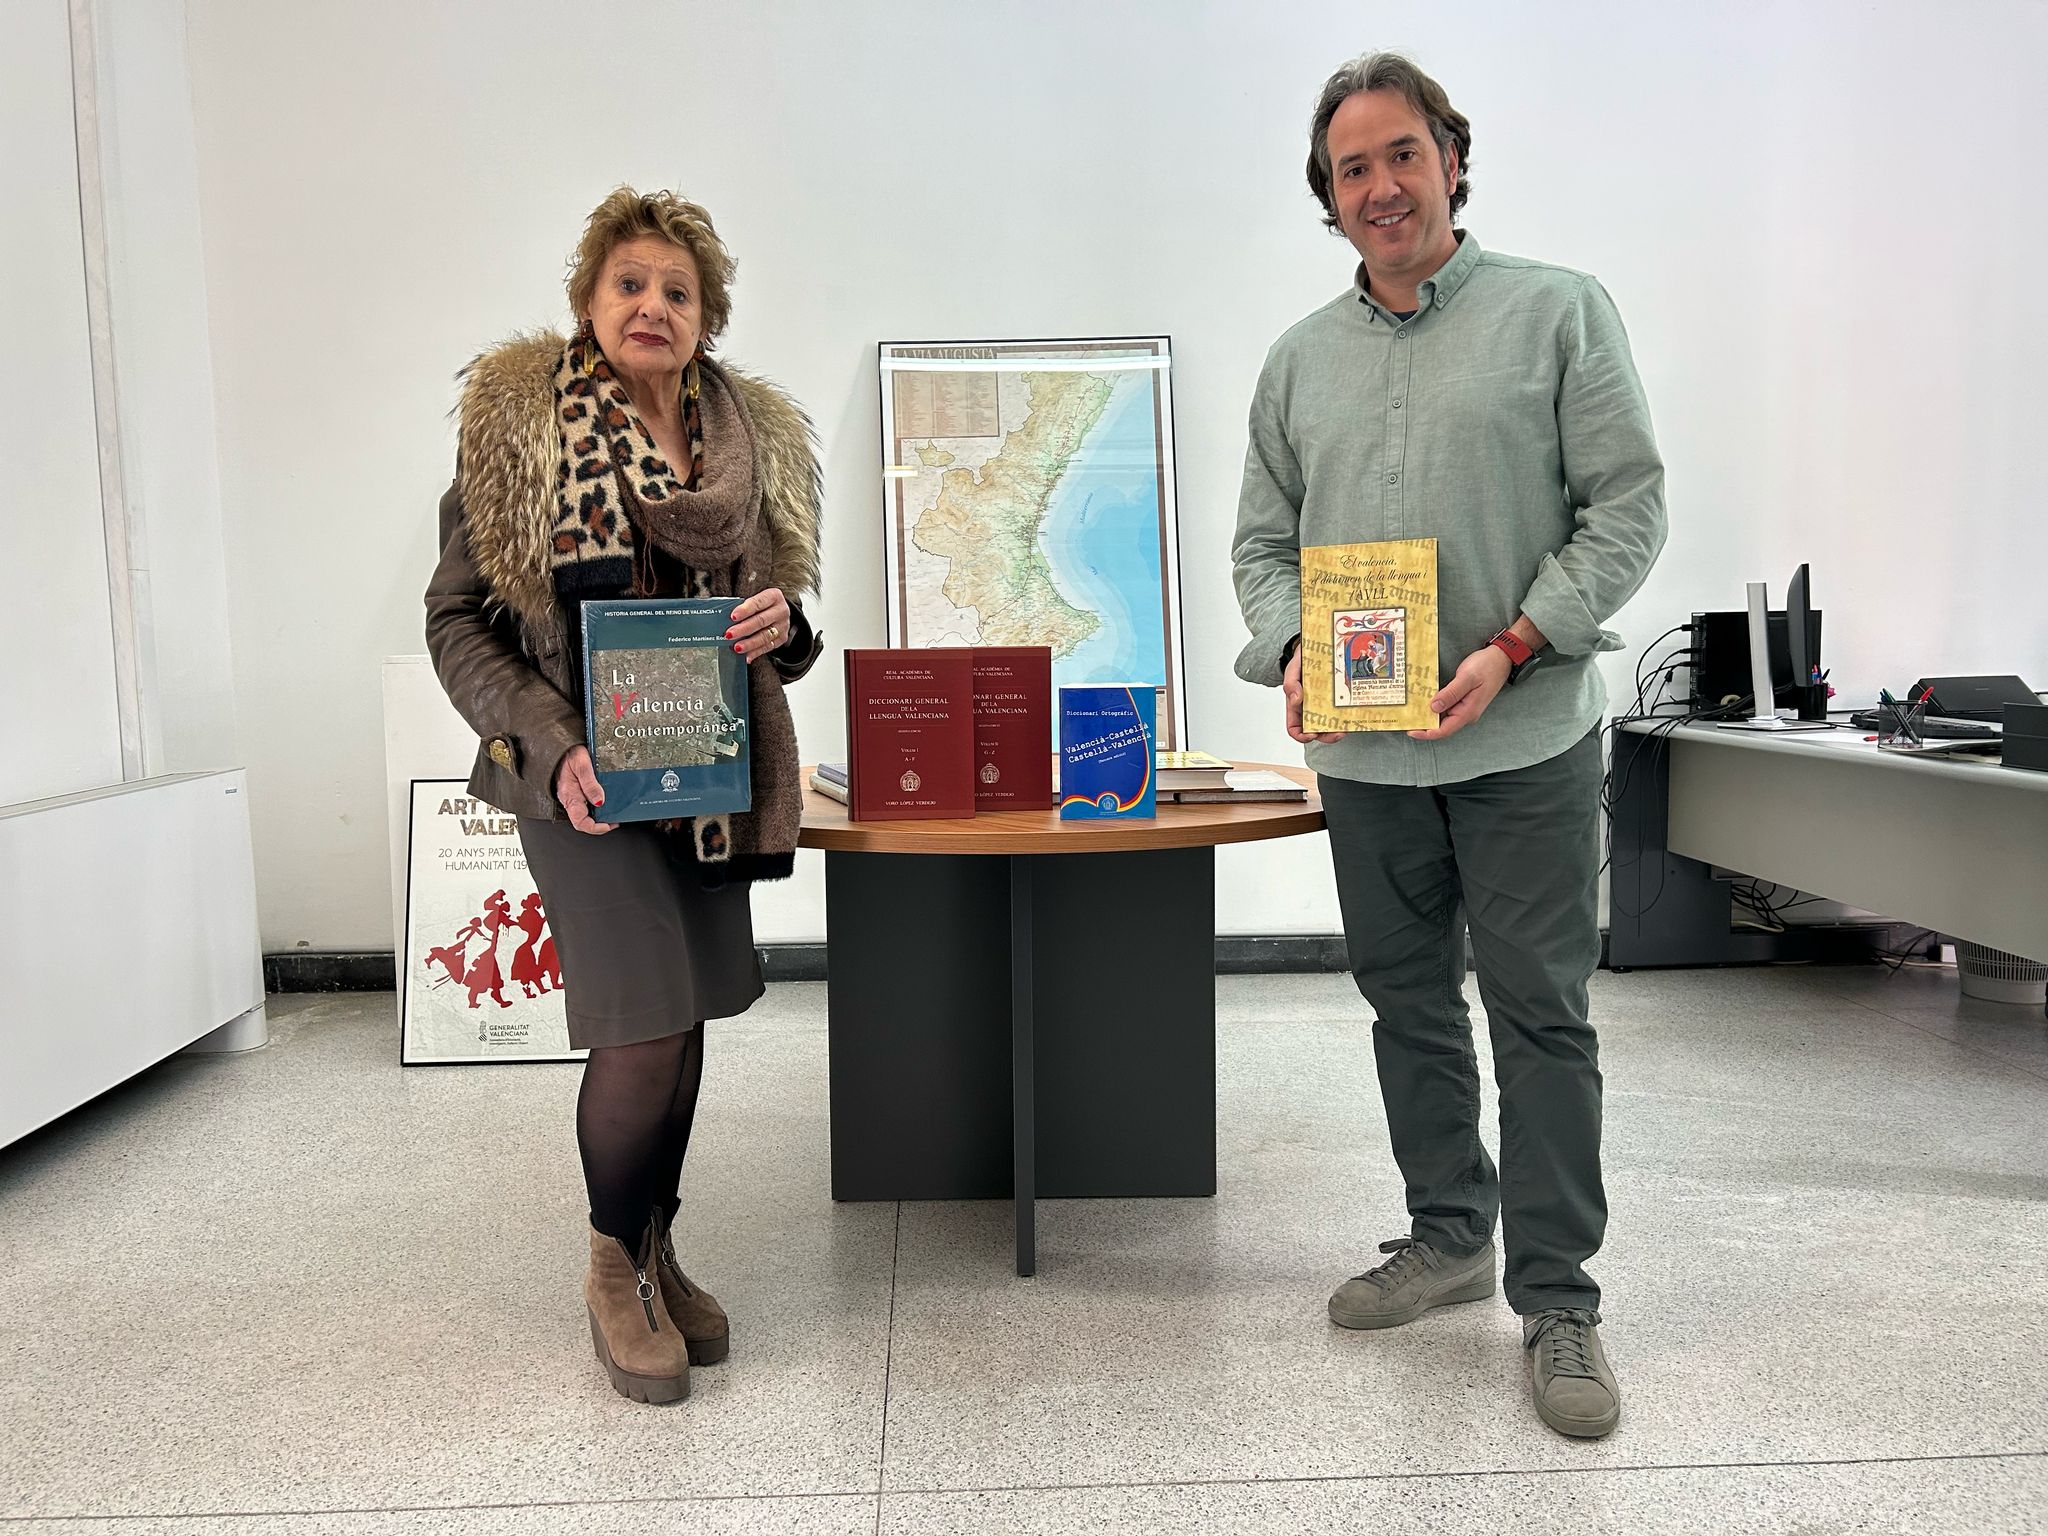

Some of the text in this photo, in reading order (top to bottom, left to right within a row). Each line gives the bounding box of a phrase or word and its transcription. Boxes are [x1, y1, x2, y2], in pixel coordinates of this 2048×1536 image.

[912, 349, 932, 359] VIA
[937, 348, 995, 360] AUGUSTA
[1340, 554, 1357, 569] El
[1320, 574, 1362, 585] dictamen
[1363, 572, 1375, 582] de
[1376, 571, 1387, 581] la
[1387, 569, 1420, 586] llengua
[1422, 569, 1428, 579] i
[612, 669, 636, 686] La
[612, 690, 704, 721] Valencia
[1065, 721, 1150, 754] Valencià-Castellà
[1068, 731, 1152, 763] Castellà-Valencià
[438, 798, 480, 815] ART
[460, 818, 518, 836] VALEN
[438, 847, 526, 858] 20 ANYS PATRIM
[445, 859, 528, 871] HUMANITAT (19
